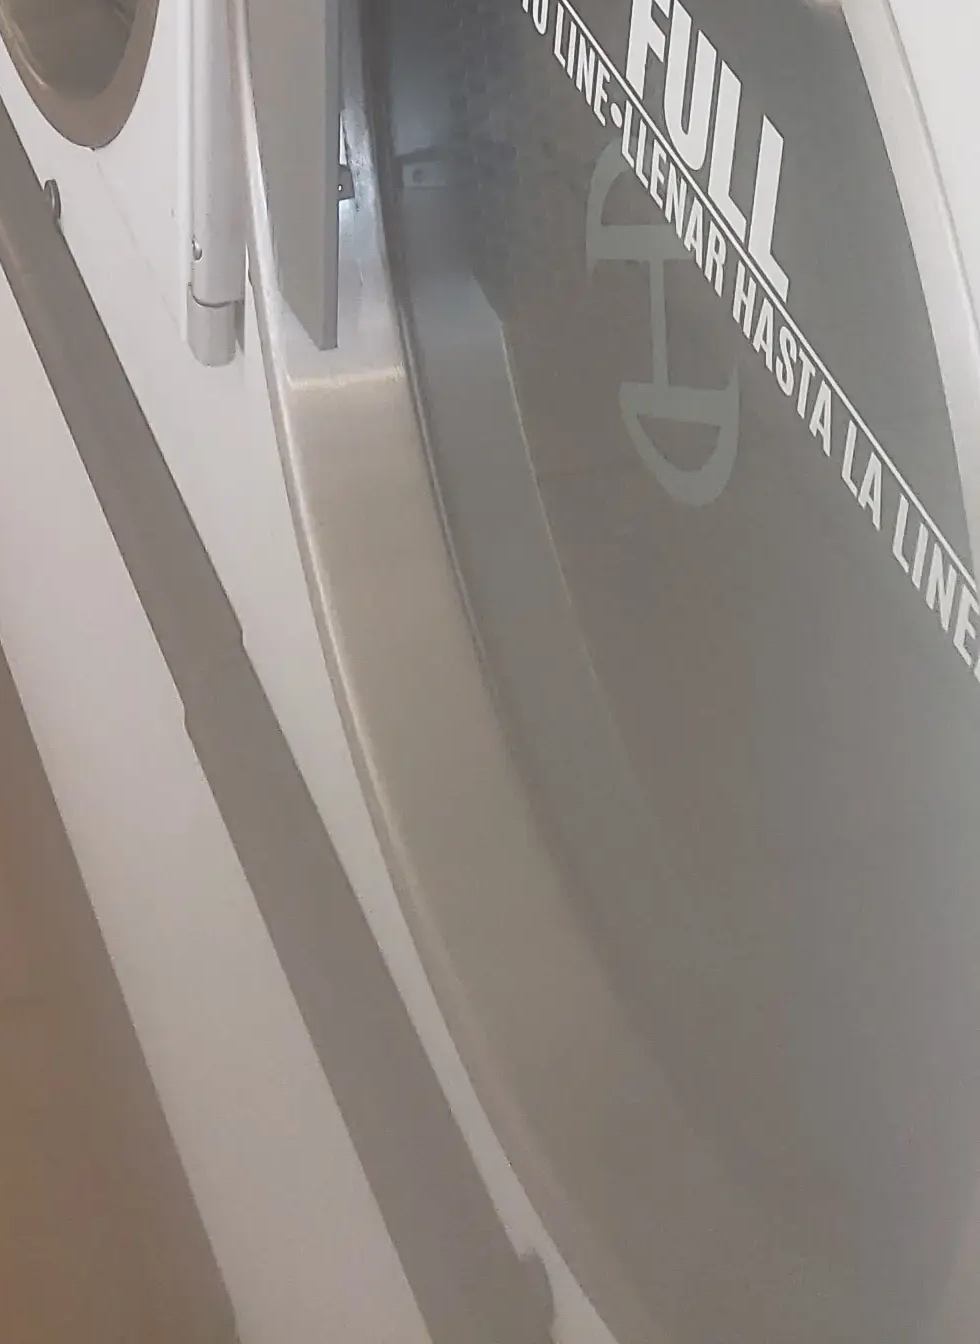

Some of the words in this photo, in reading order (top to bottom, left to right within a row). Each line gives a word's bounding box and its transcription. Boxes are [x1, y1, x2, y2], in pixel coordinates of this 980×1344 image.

[733, 264, 836, 457] HASTA
[841, 415, 883, 534] LA
[892, 490, 980, 684] LINE
